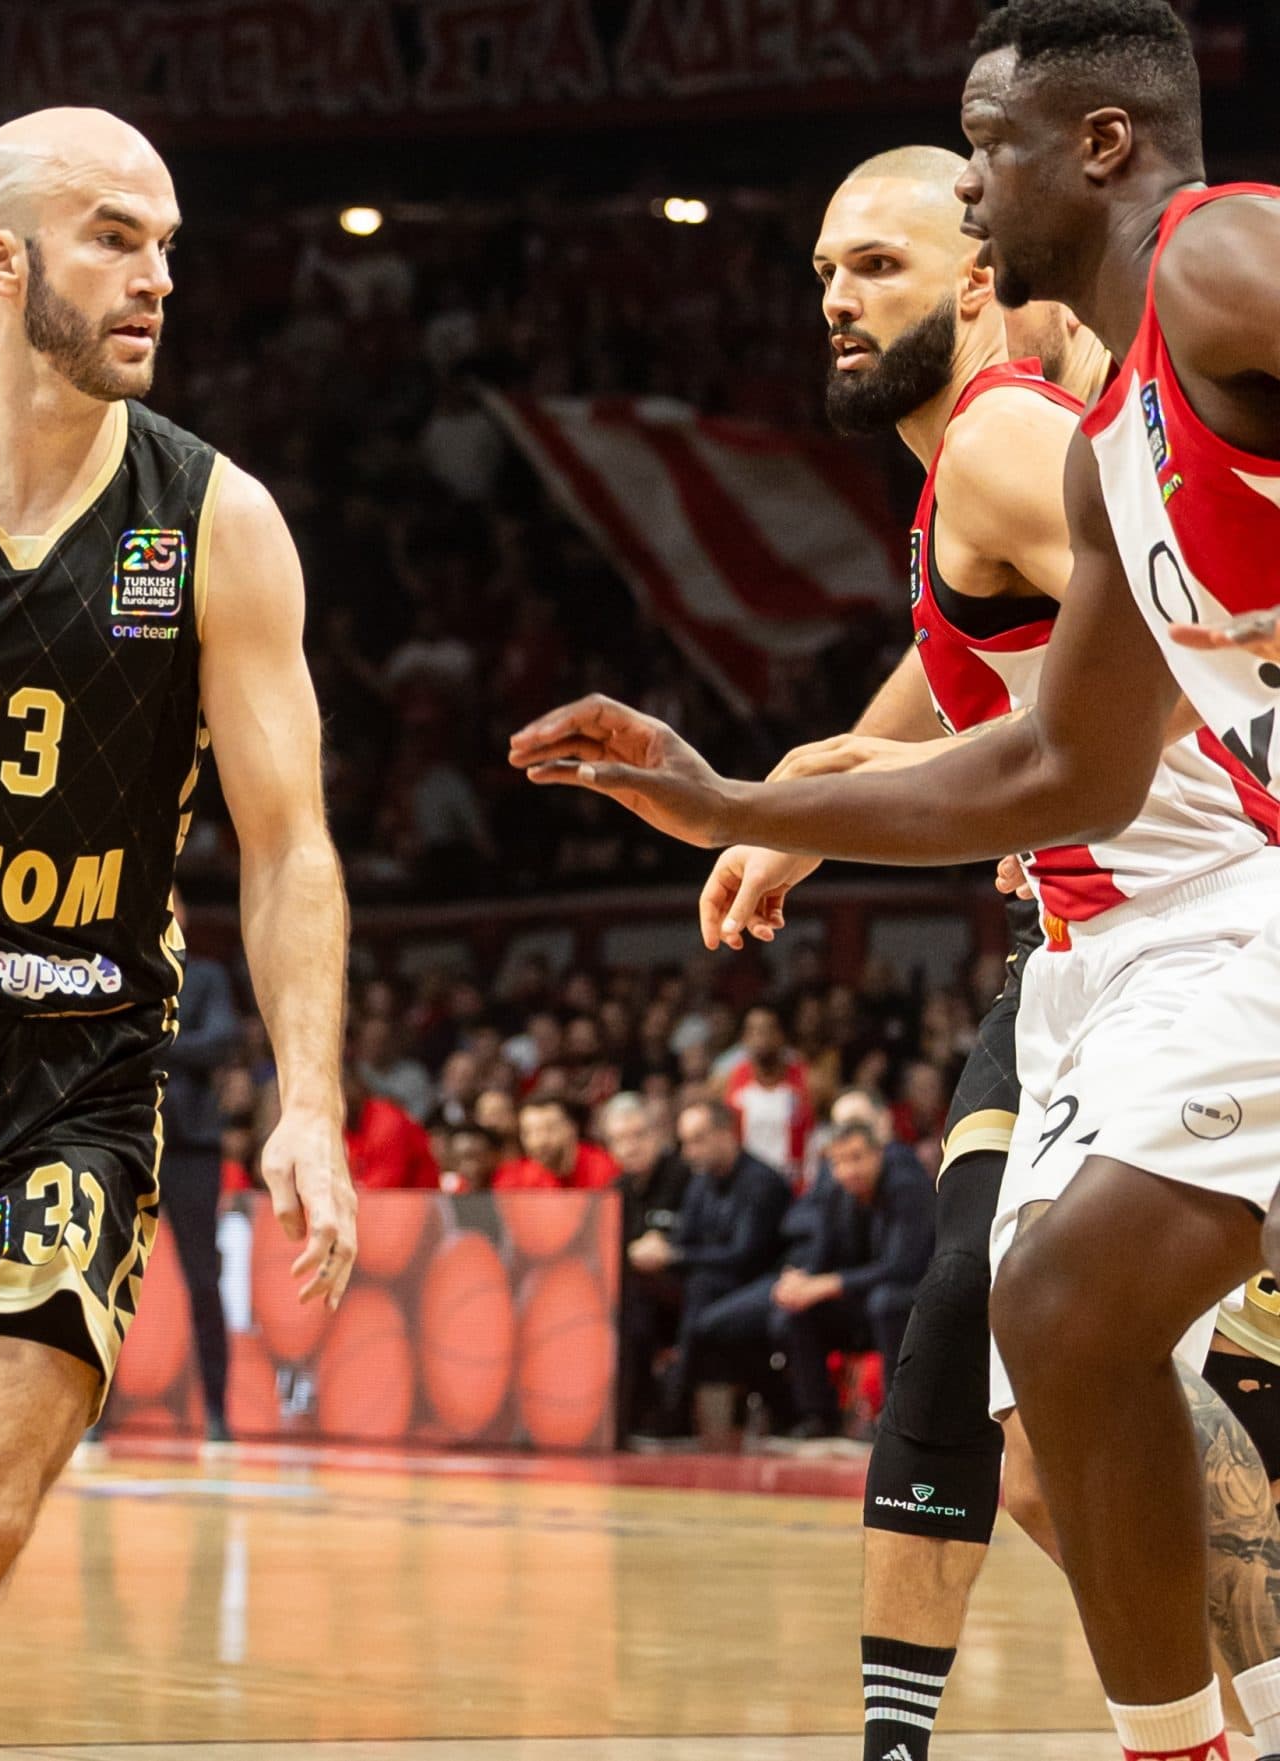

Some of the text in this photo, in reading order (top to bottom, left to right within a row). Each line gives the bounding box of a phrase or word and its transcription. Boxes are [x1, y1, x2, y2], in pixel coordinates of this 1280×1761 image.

[124, 577, 175, 587] TURKISH
[123, 587, 176, 597] AIRLINES
[122, 597, 175, 607] EuroLeague
[875, 1496, 966, 1517] GAMEPATCH
